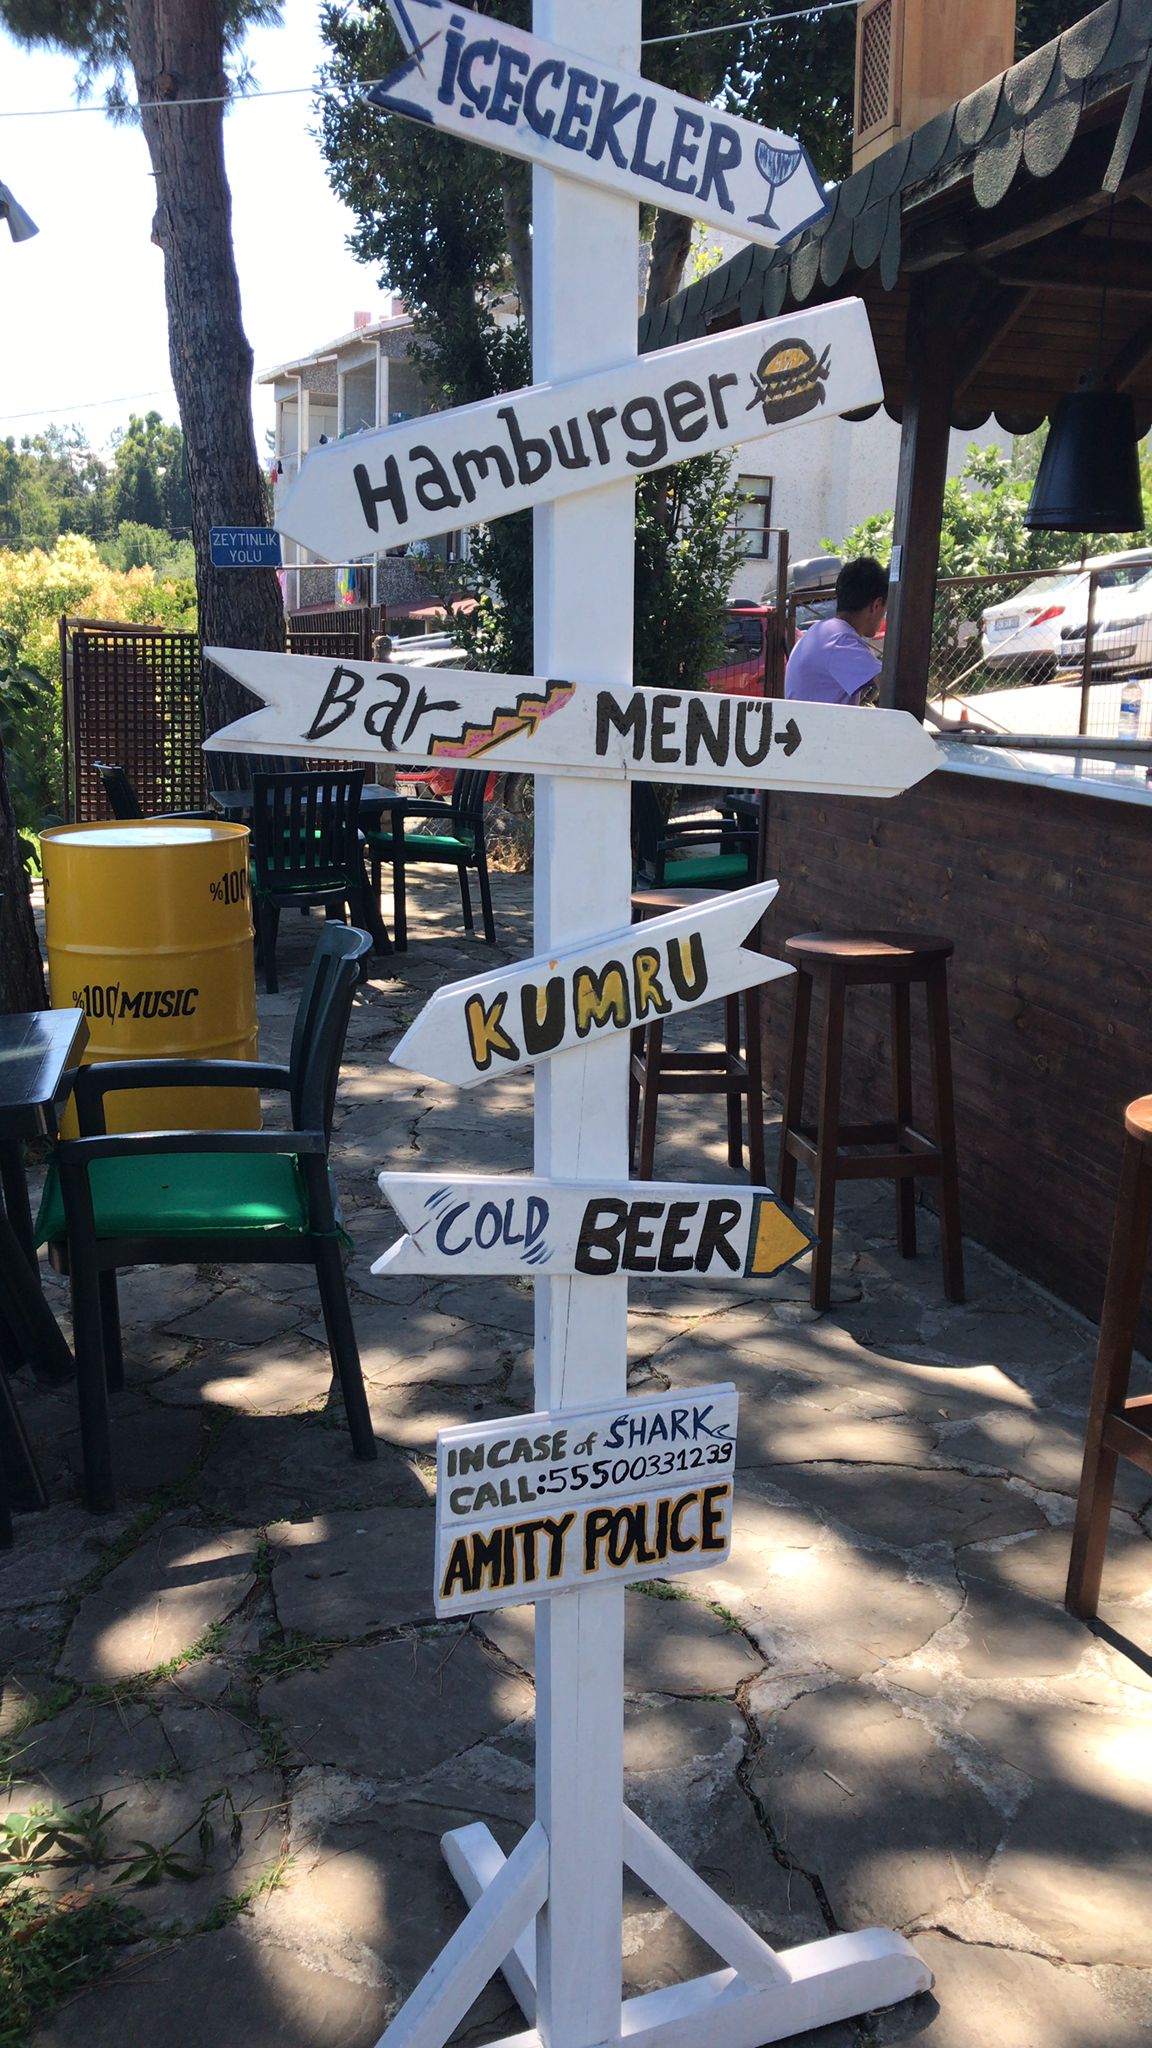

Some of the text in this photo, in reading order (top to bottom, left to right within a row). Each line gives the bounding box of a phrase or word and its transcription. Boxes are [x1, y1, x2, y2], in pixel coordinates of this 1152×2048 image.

[353, 372, 738, 533] Hamburger
[229, 549, 262, 563] YOLU
[300, 664, 772, 768] Bar MENÜ
[464, 931, 709, 1071] KUMRU
[435, 1195, 742, 1275] COLD BEER
[573, 1431, 599, 1457] of
[603, 1404, 737, 1450] SHARK
[439, 1482, 732, 1600] AMITY POLICE
